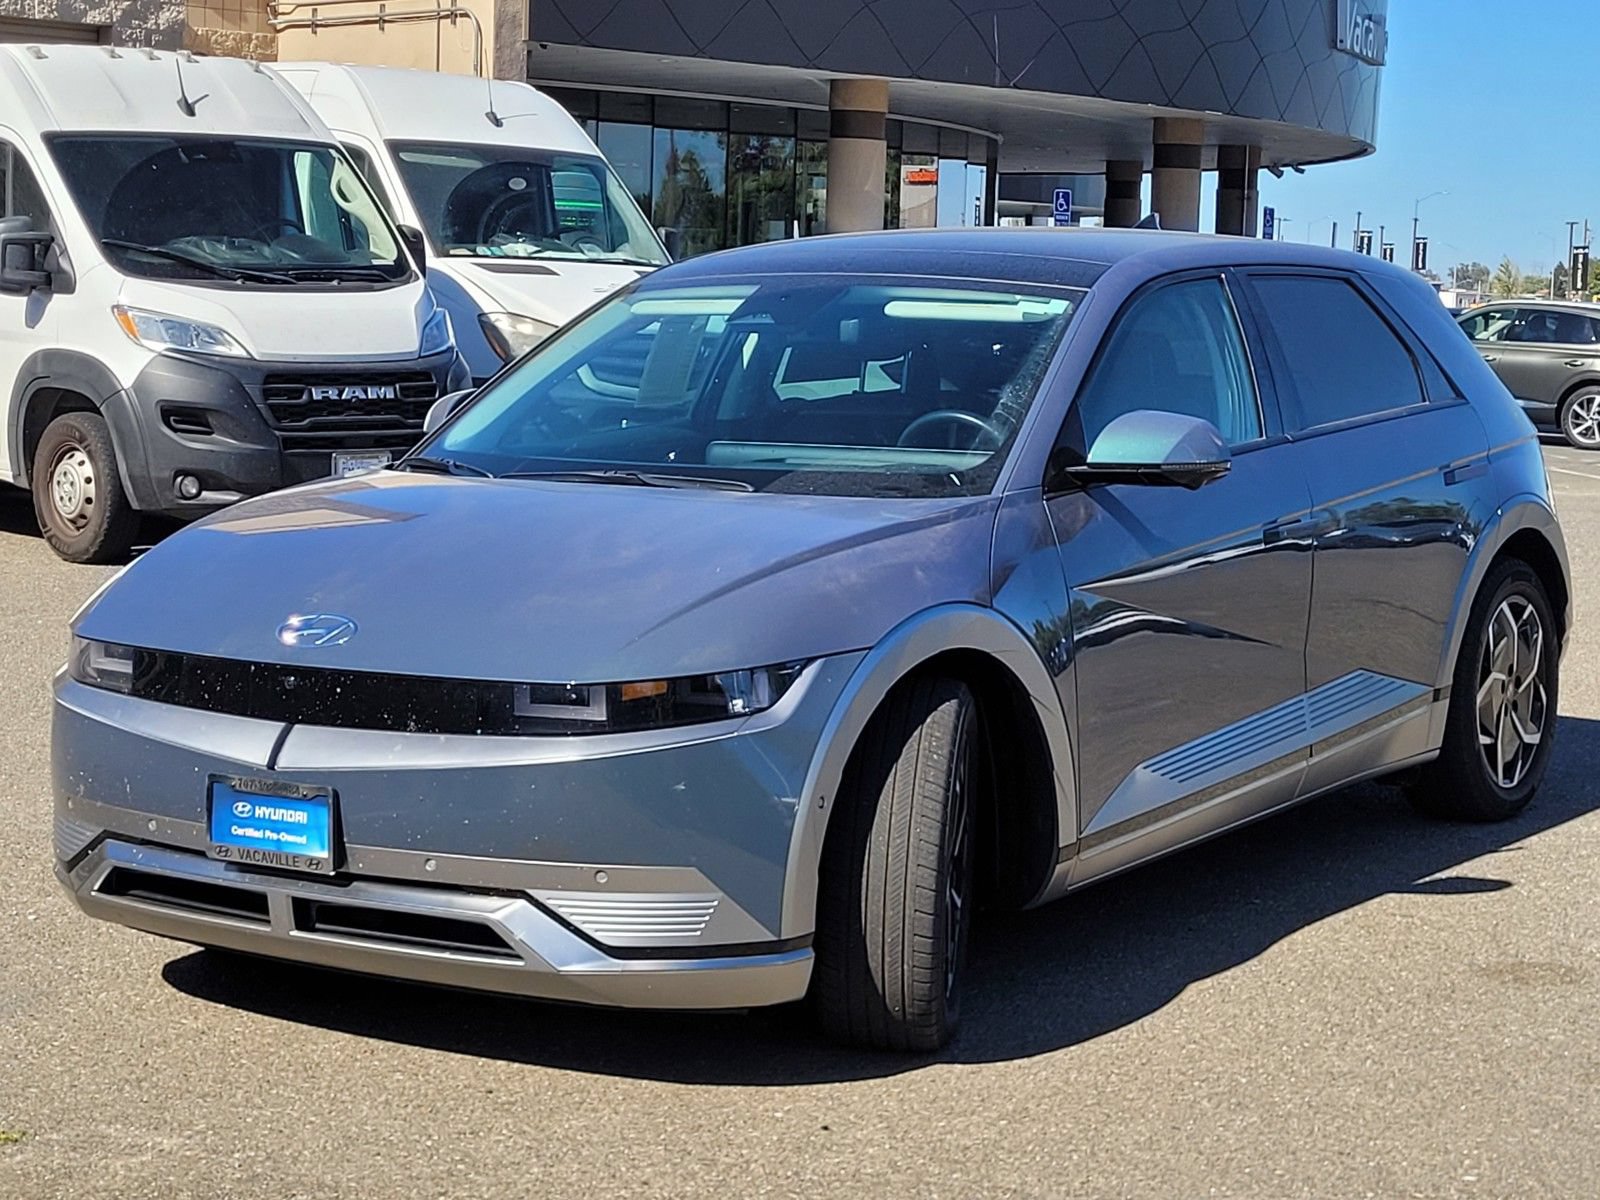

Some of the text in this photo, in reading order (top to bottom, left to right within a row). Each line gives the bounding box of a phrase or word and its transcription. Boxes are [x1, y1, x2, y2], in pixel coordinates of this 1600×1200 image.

[1346, 0, 1378, 59] Vaca
[311, 386, 395, 400] RAM
[255, 805, 308, 824] HYUNDAI
[231, 825, 307, 844] Certified Pre-Owned
[238, 848, 300, 868] VACAVILLE
